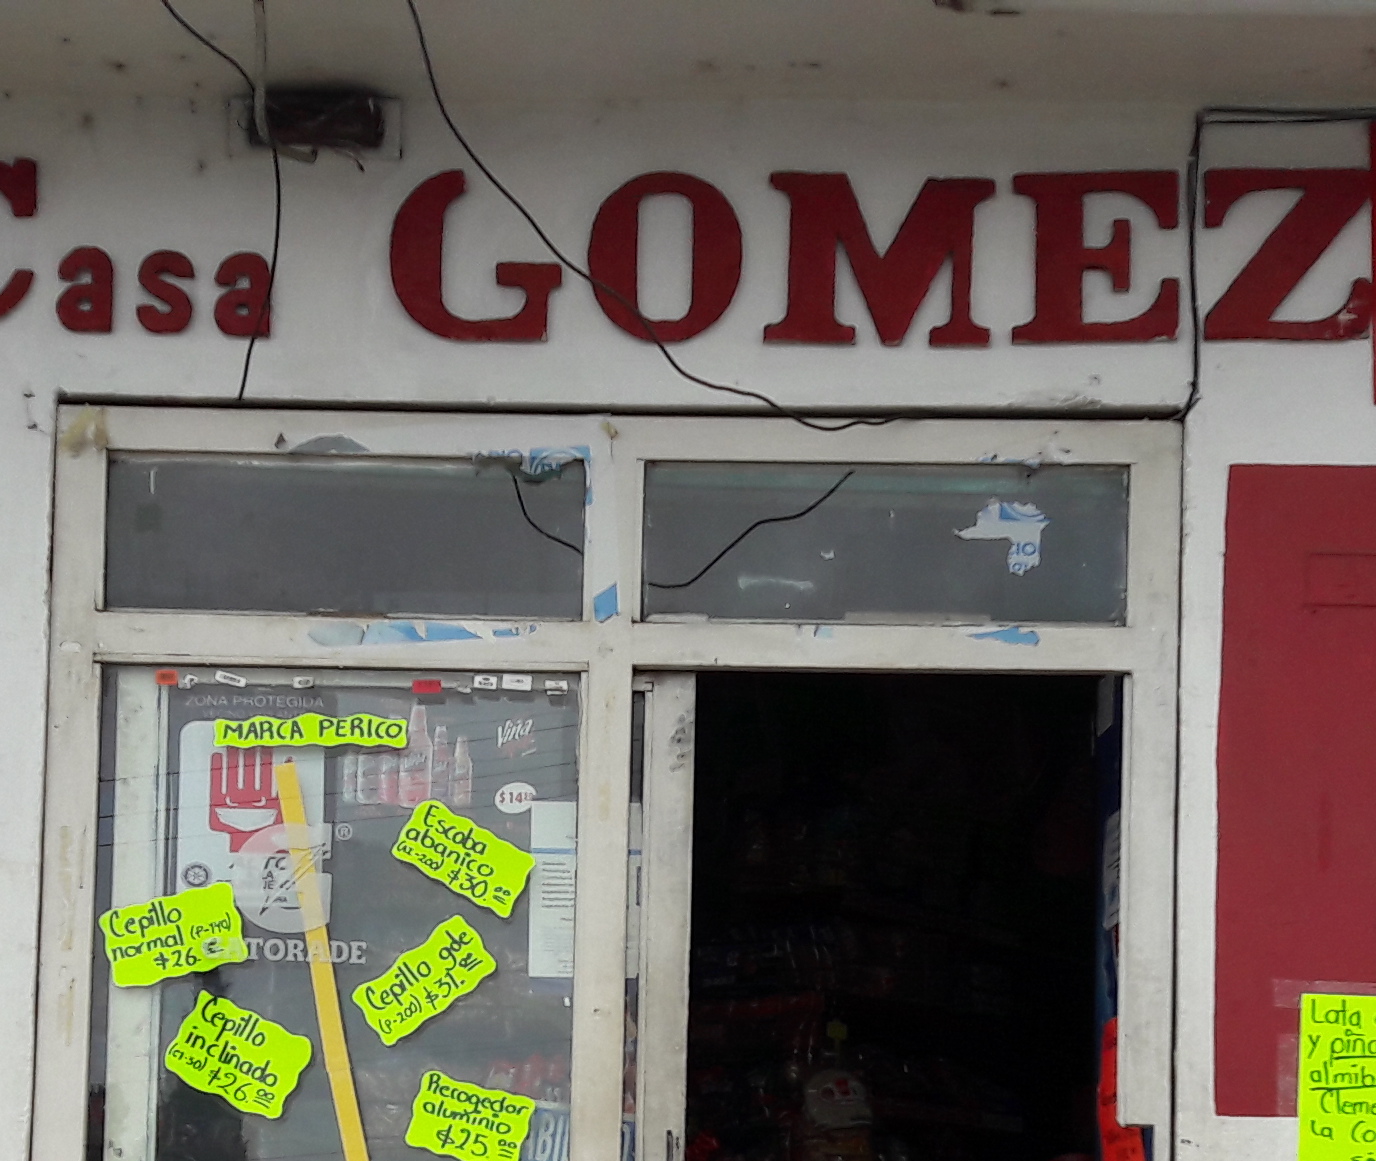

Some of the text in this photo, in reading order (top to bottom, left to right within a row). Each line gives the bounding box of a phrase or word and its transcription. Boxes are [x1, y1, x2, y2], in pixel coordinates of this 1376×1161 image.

[389, 167, 1373, 347] GOMEZ
[222, 718, 403, 741] MARCA PERICO
[405, 828, 495, 877] abanico
[424, 804, 487, 855] Escoba
[109, 900, 183, 938] Cepillo
[110, 924, 185, 962] normal
[365, 961, 432, 1010] Cepillo
[201, 996, 266, 1047] Cepillo
[1310, 998, 1362, 1027] Lata
[185, 1026, 278, 1087] inclinado
[422, 1100, 512, 1136] aluminio
[426, 1073, 530, 1117] Recogedor
